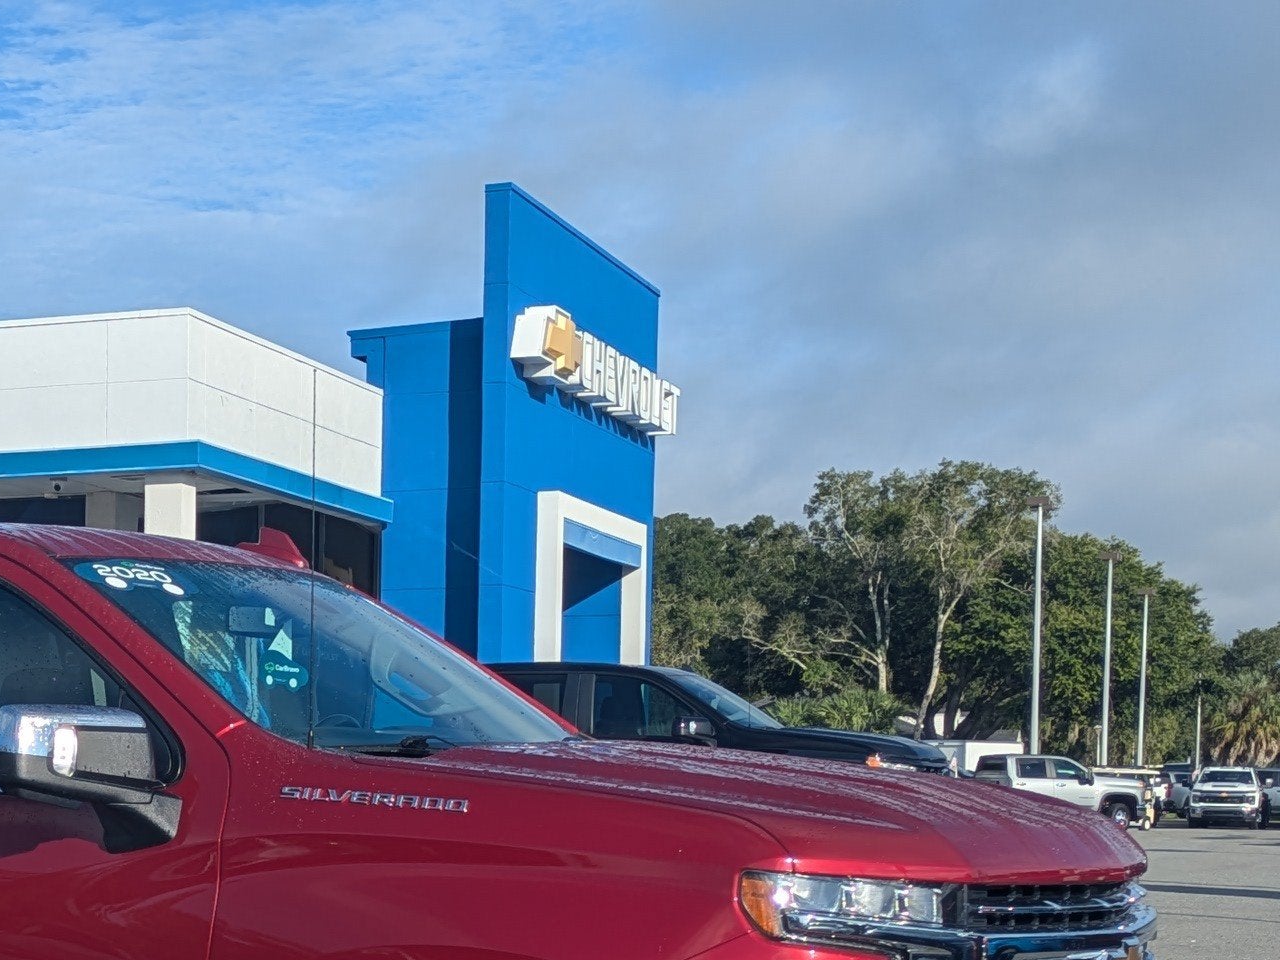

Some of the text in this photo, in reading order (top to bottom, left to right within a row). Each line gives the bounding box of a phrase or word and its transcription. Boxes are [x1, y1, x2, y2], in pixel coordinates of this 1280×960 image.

[581, 330, 680, 435] CHEVROLET
[92, 564, 172, 583] 2020
[280, 786, 469, 812] SILVERADO
